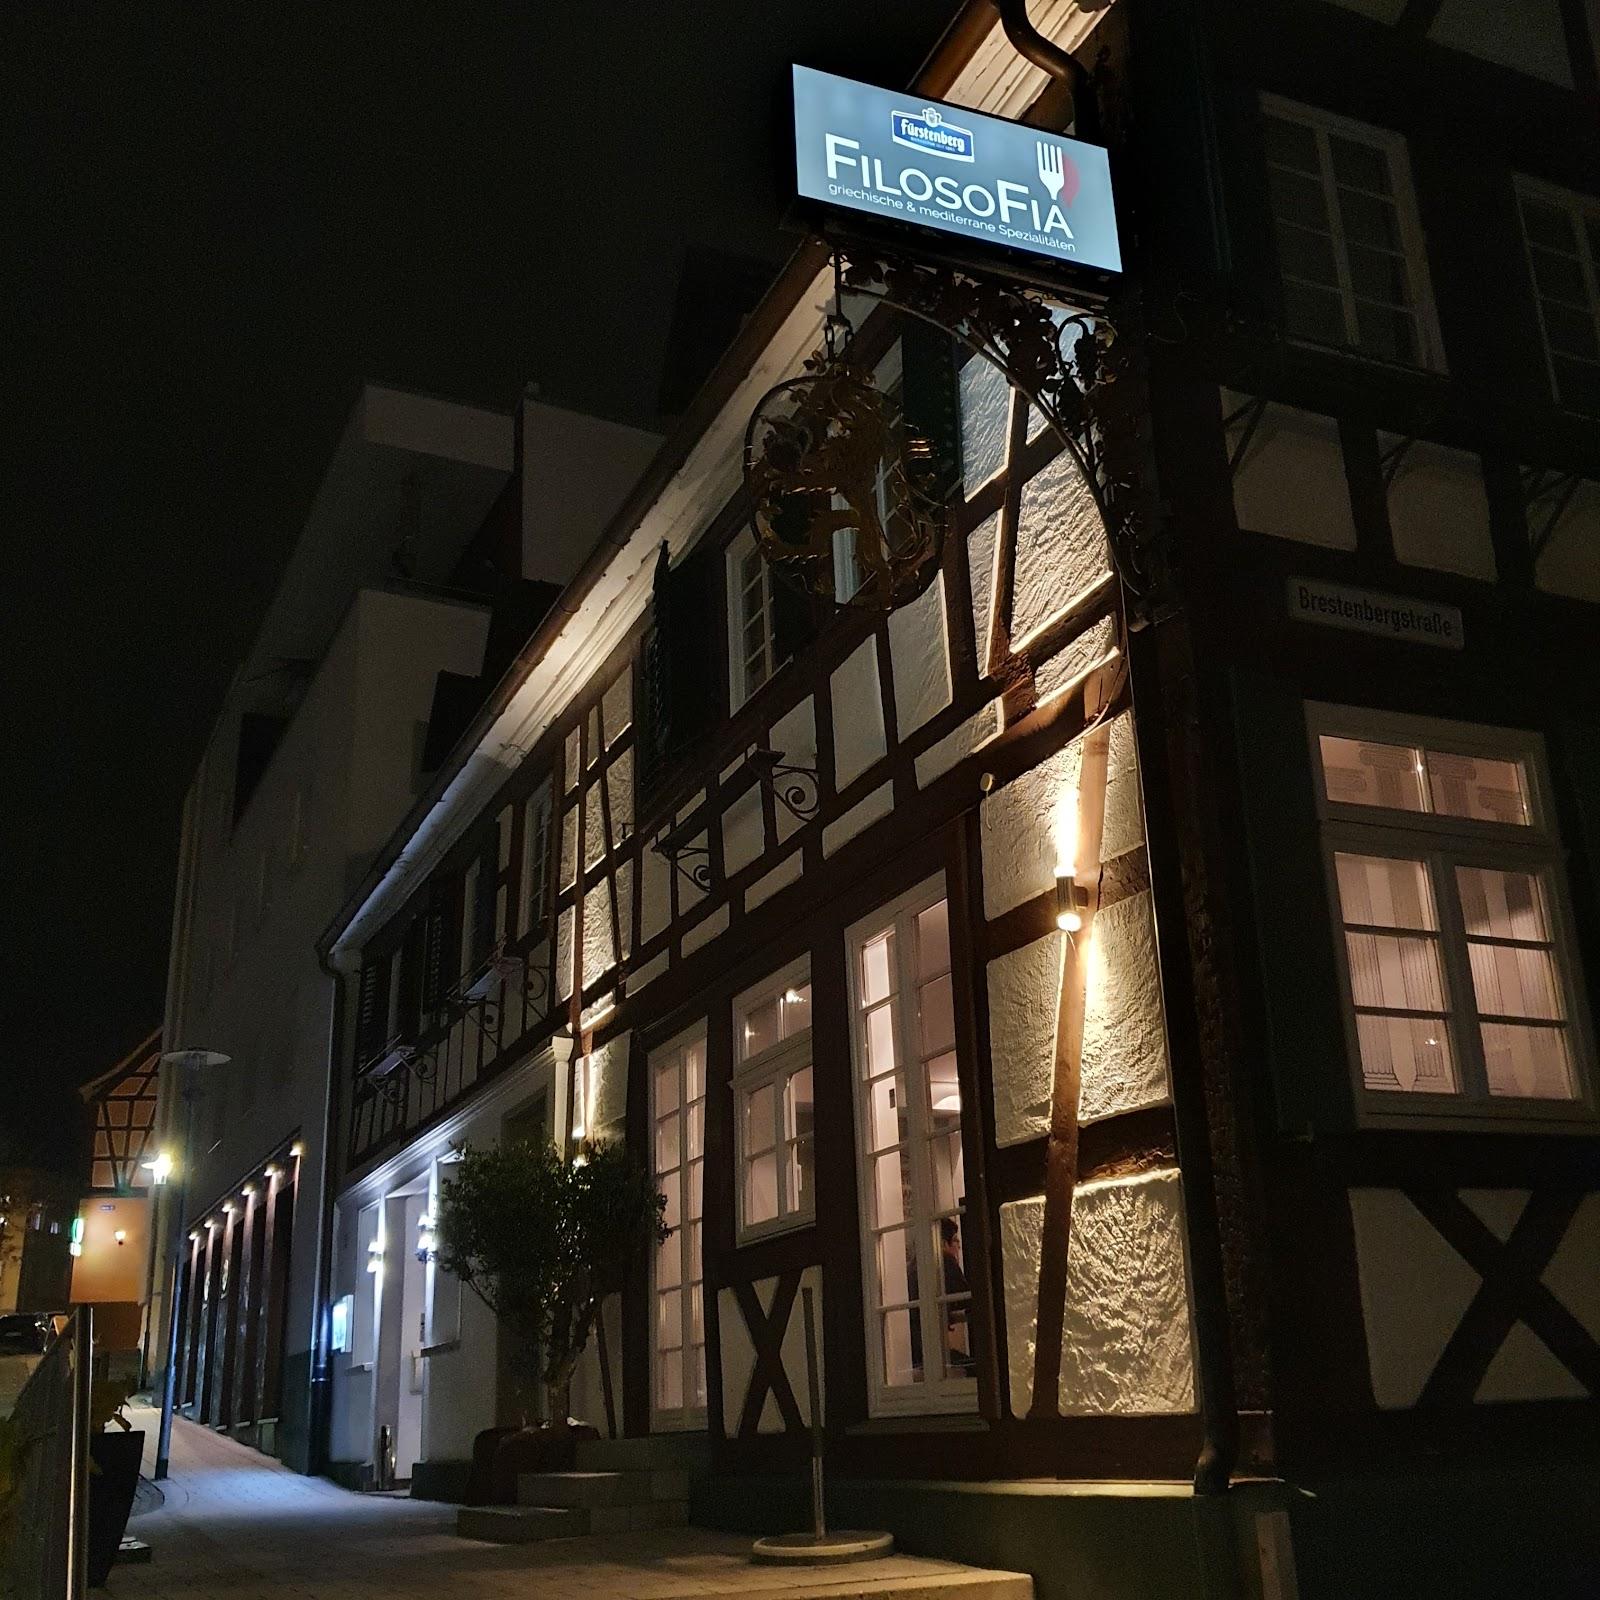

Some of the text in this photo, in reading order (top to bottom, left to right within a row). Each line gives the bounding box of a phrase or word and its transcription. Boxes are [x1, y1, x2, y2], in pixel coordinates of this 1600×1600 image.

[828, 183, 1076, 252] griechische & mediterrane Spezialitäten
[1299, 586, 1451, 636] Brestenbergstraße
